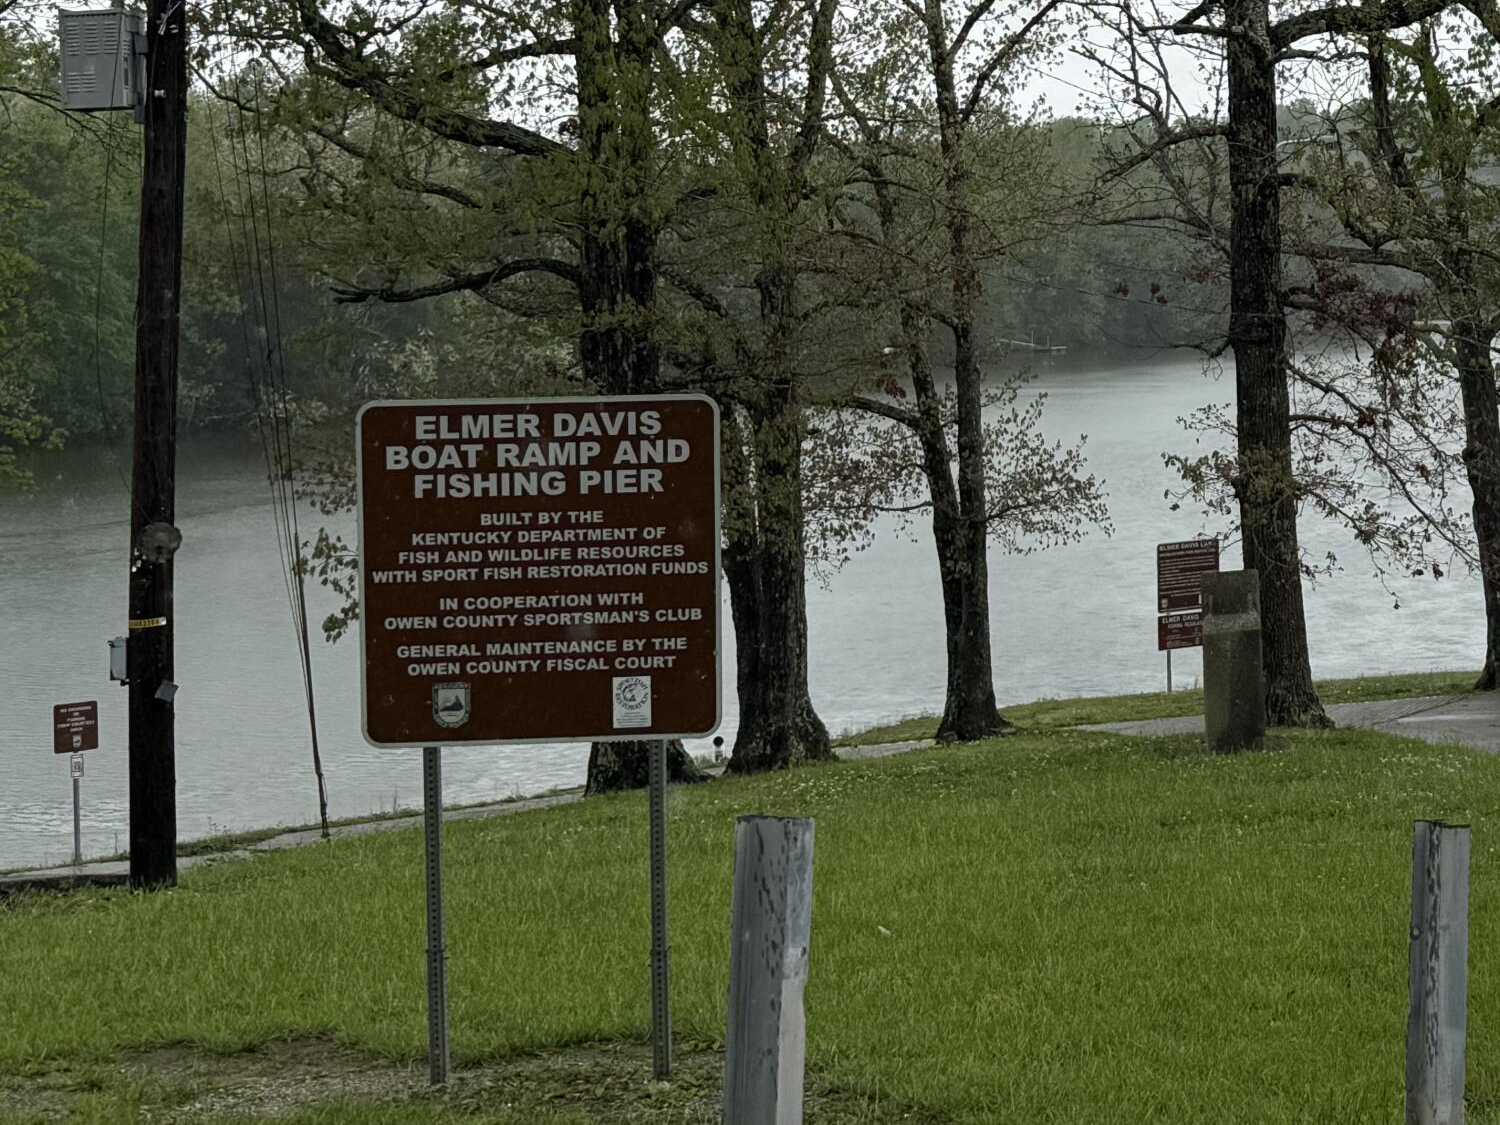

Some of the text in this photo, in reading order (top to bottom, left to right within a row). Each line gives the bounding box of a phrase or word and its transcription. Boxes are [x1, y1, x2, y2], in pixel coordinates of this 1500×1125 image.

[416, 411, 661, 439] ELMER DAVIS
[386, 439, 689, 469] BOAT RAMP AND
[415, 469, 663, 498] FISHING PIER
[481, 511, 603, 525] BUILT BY THE
[413, 527, 665, 545] KENTUCKY DEPARTMENT OF
[399, 545, 684, 563] FISH AND WILDLIFE RESOURCES
[373, 562, 708, 583] WITH SPORT FISH RESTORATION FUNDS
[440, 593, 643, 610] IN COOPERATION WITH
[385, 609, 702, 629] OWEN COUNTY SPORTSMAN'S CLUB
[1162, 616, 1181, 624] ELMER
[397, 638, 687, 657] GENERAL MAINTENANCE BY THE
[408, 656, 676, 675] OWEN COUNTY FISCAL COURT
